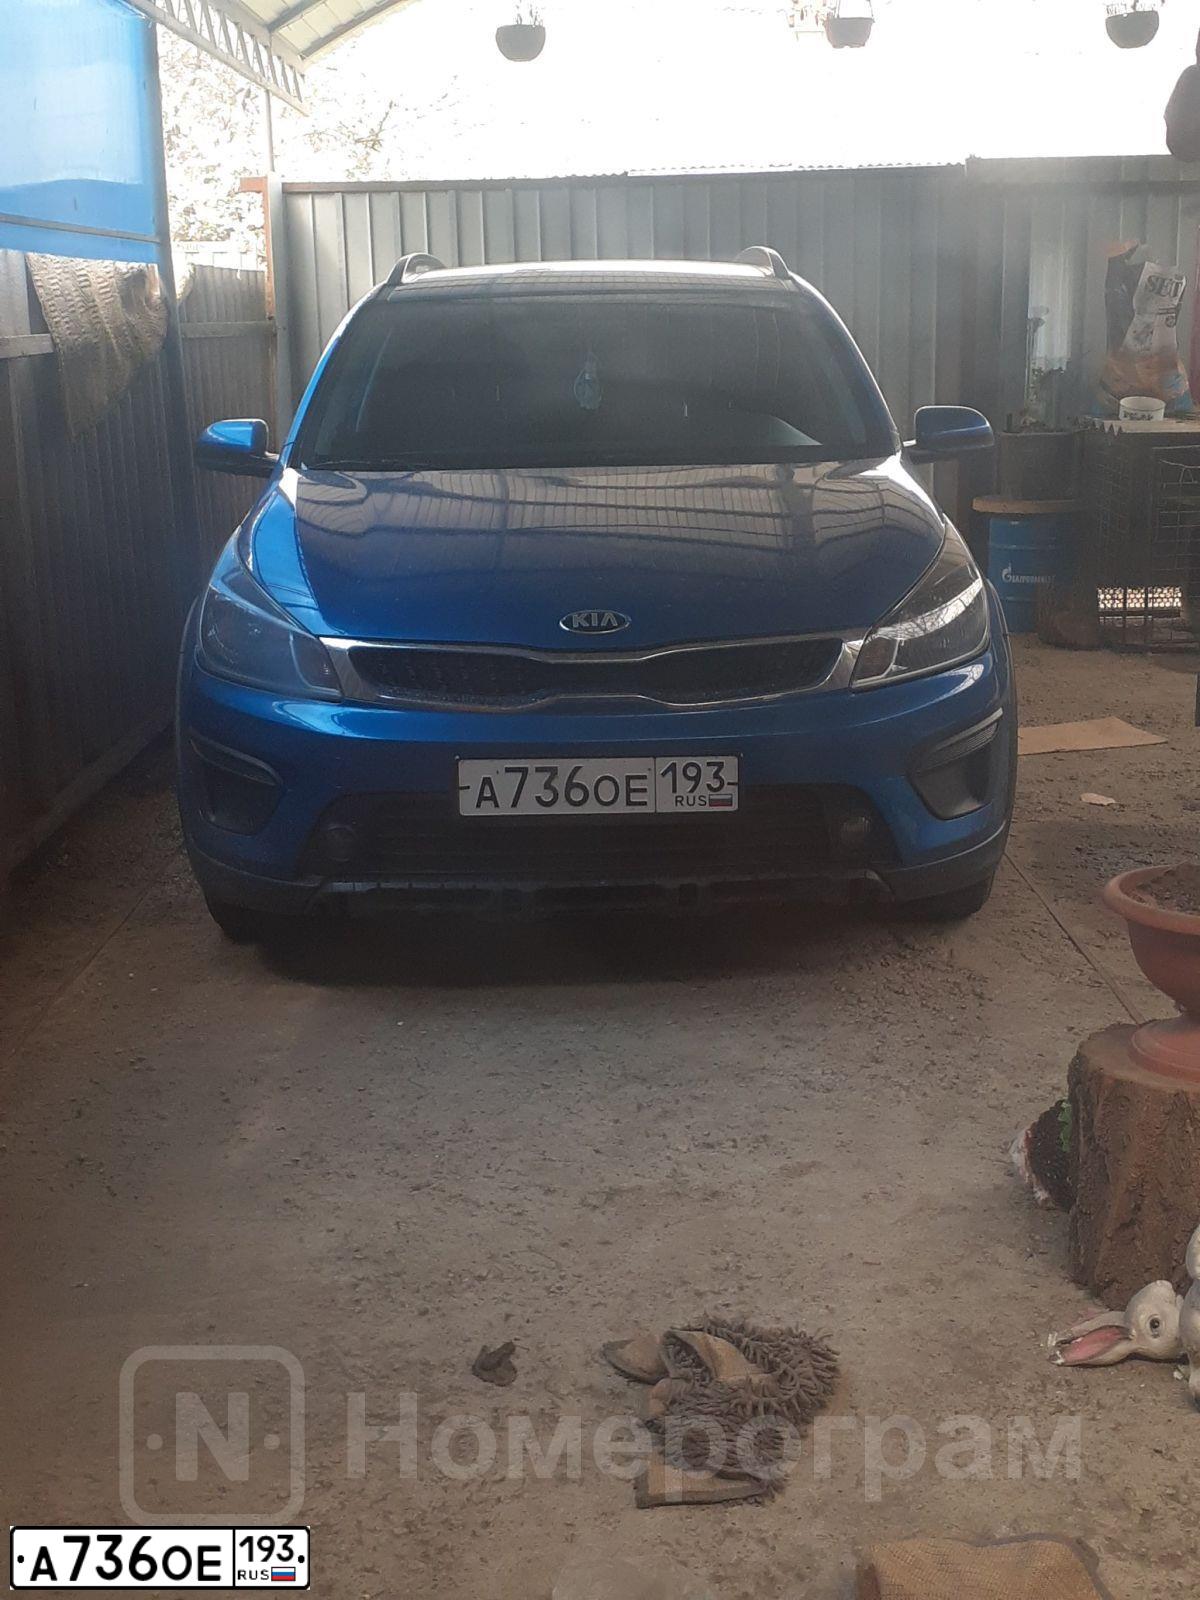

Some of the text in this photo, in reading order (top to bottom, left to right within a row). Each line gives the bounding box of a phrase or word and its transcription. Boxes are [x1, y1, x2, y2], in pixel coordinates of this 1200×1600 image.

[572, 612, 618, 628] KIA
[660, 761, 725, 794] 193
[674, 795, 707, 807] RUS
